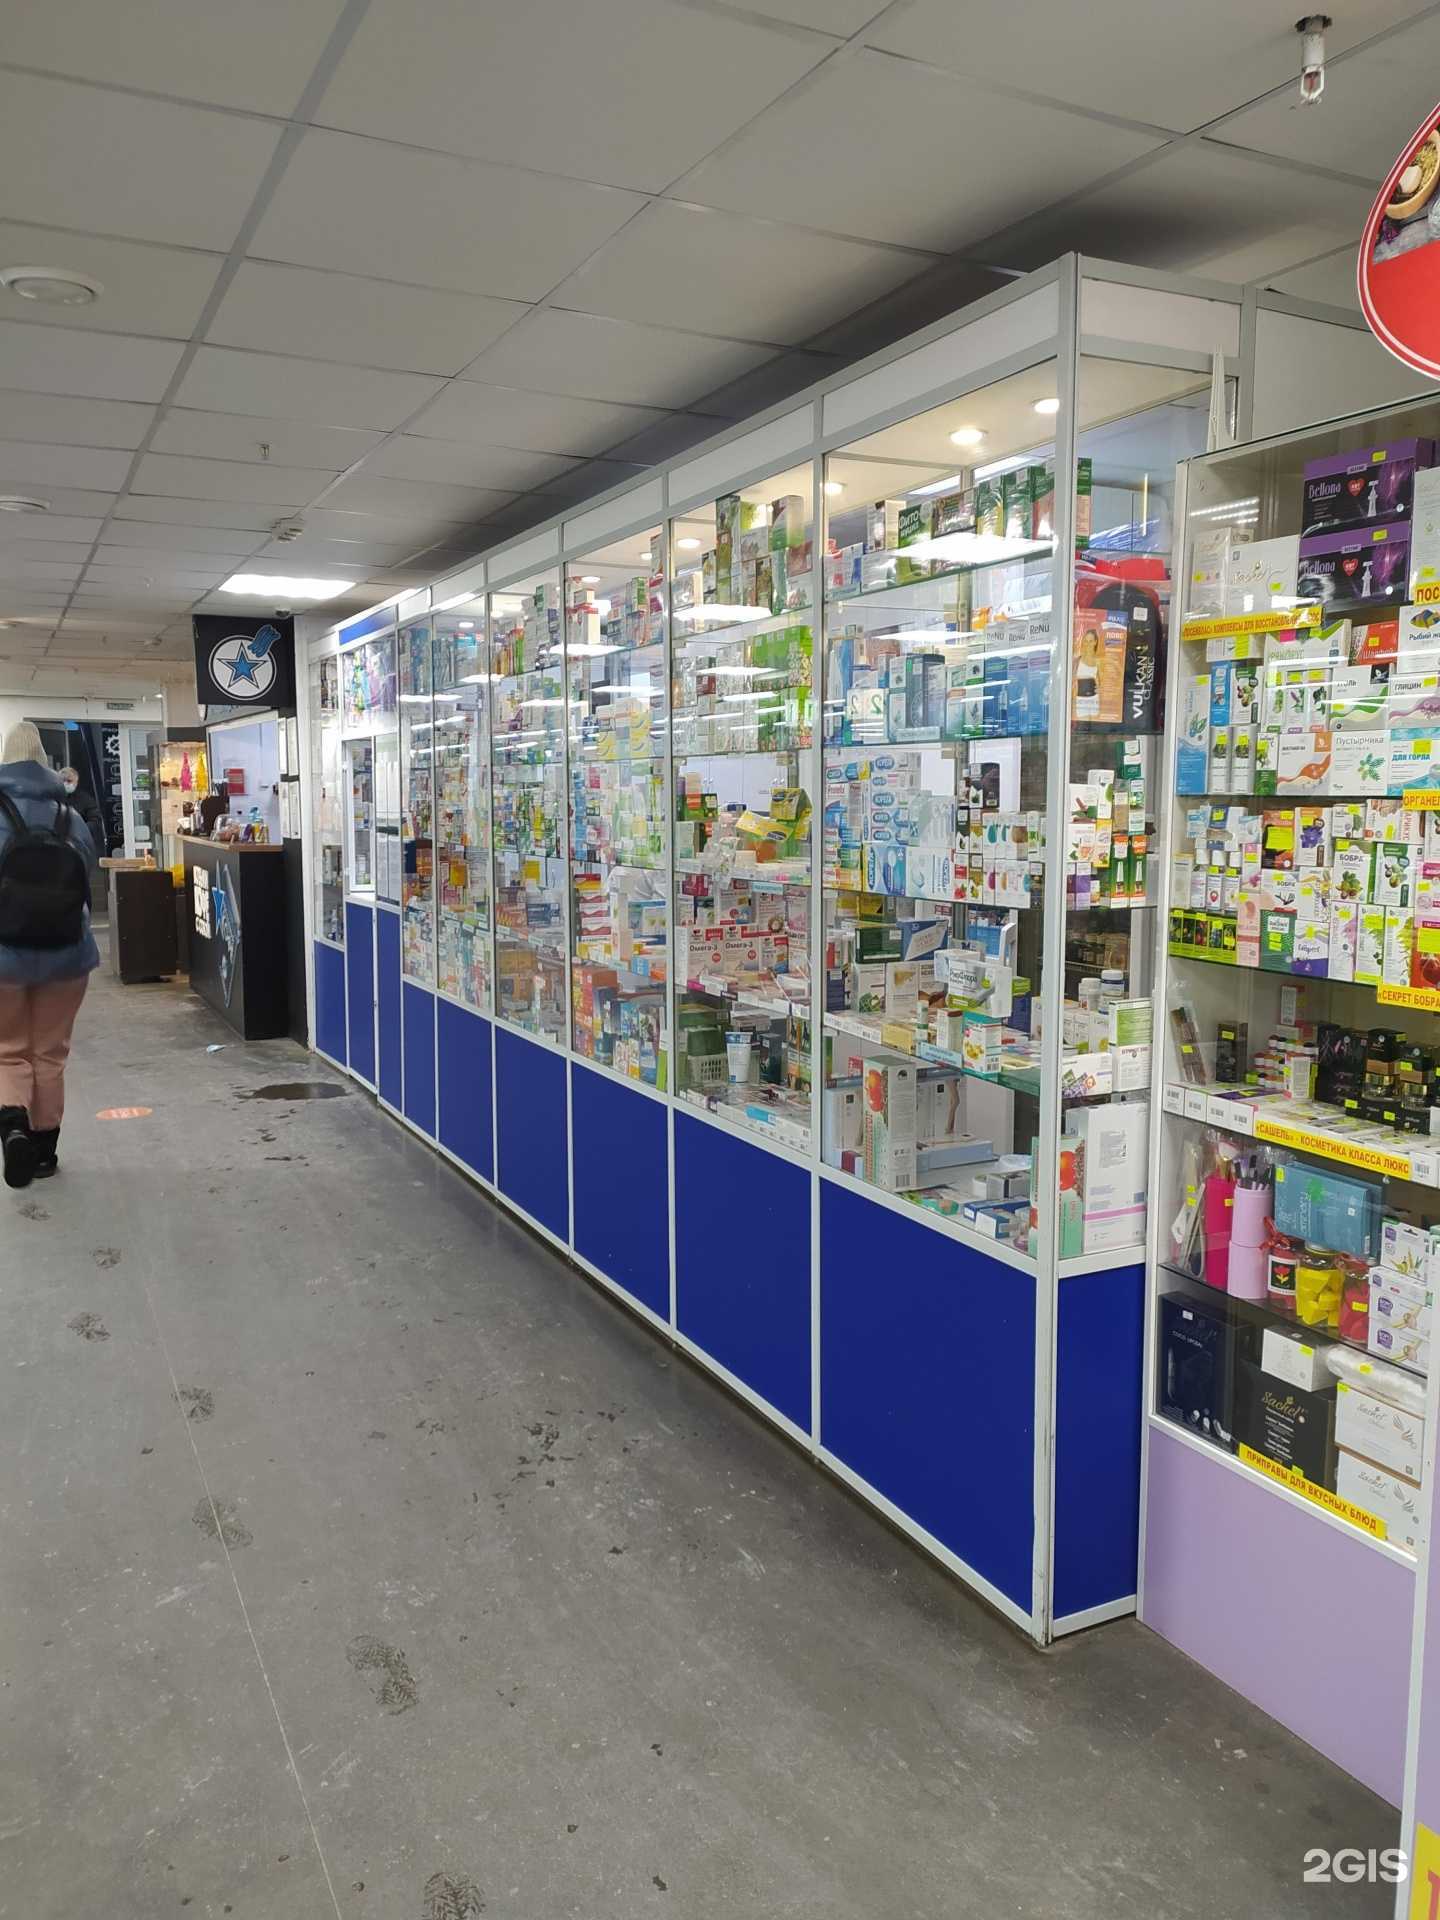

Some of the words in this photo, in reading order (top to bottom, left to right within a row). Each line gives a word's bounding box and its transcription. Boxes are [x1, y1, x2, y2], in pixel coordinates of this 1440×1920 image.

[1133, 656, 1147, 718] VULKAN
[1144, 657, 1155, 700] CLASSIC
[1395, 682, 1421, 690] ГЛИЦИН
[1336, 737, 1384, 746] Пустырника
[1408, 753, 1430, 761] ГОРЛА
[1301, 1135, 1347, 1156] КОСМЕТИКА
[1349, 1149, 1382, 1166] КЛАССА
[1383, 1159, 1409, 1174] ЛЮКС
[1246, 1449, 1288, 1482] ПРИПРАВЫ
[1290, 1475, 1306, 1492] ДЛЯ
[1308, 1486, 1348, 1515] ВКУСНЫХ
[1350, 1506, 1377, 1531] БЛЮД
